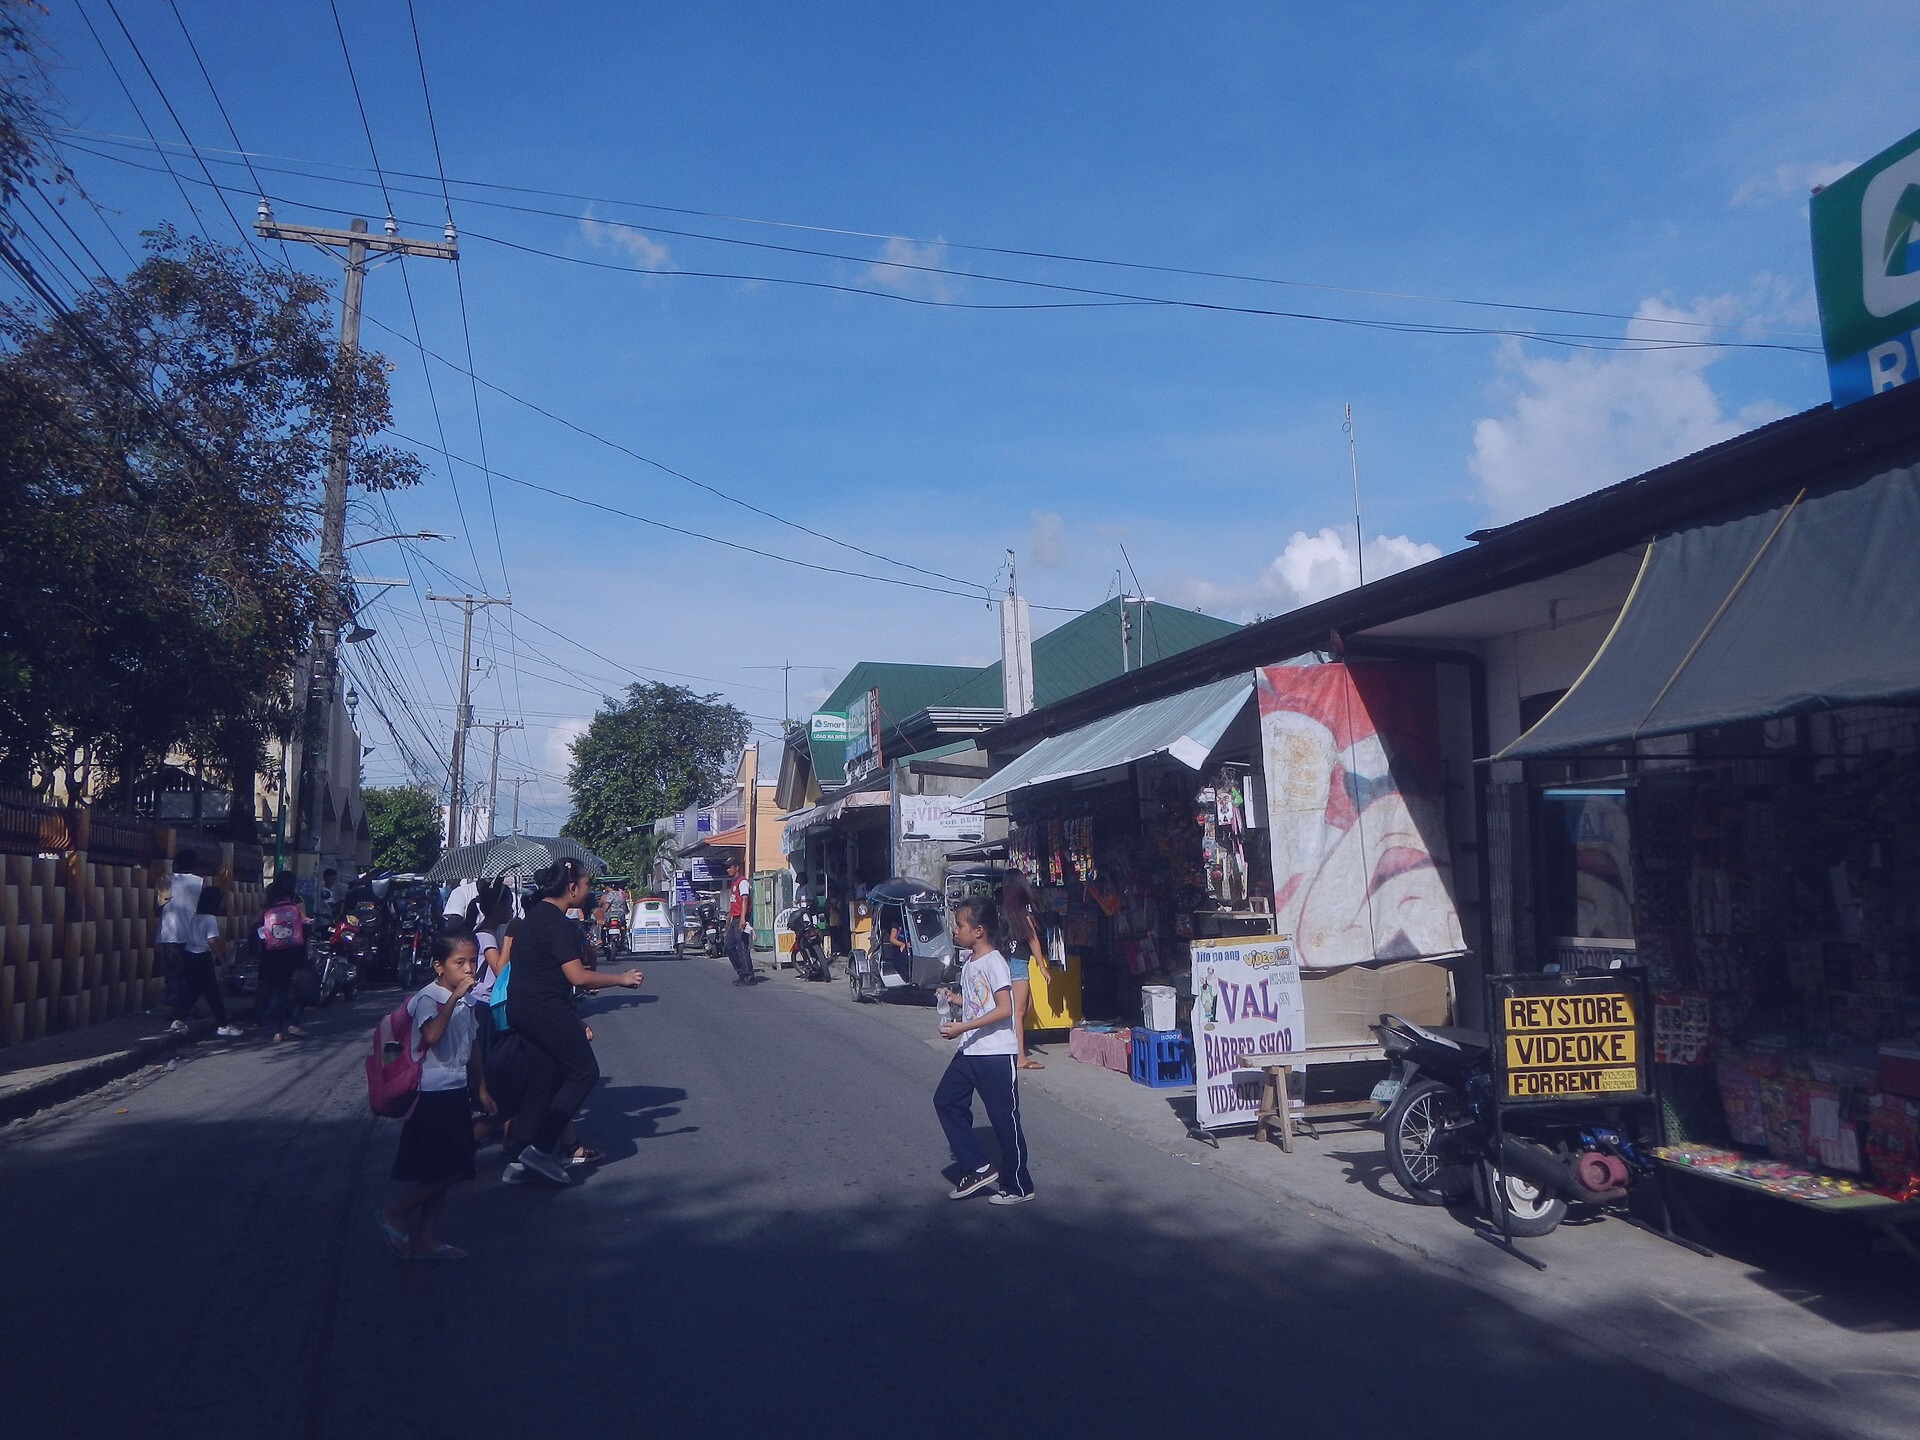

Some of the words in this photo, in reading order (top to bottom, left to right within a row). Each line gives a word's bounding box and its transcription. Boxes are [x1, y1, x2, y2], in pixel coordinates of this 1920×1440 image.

[940, 818, 957, 826] FOR
[960, 816, 983, 825] RENT
[1212, 951, 1223, 963] po
[1225, 950, 1240, 961] ang
[1218, 977, 1279, 1025] VAL
[1204, 1032, 1256, 1081] BARBER
[1515, 1034, 1627, 1064] VIDEOKE
[1207, 1083, 1261, 1114] VIDEOKE
